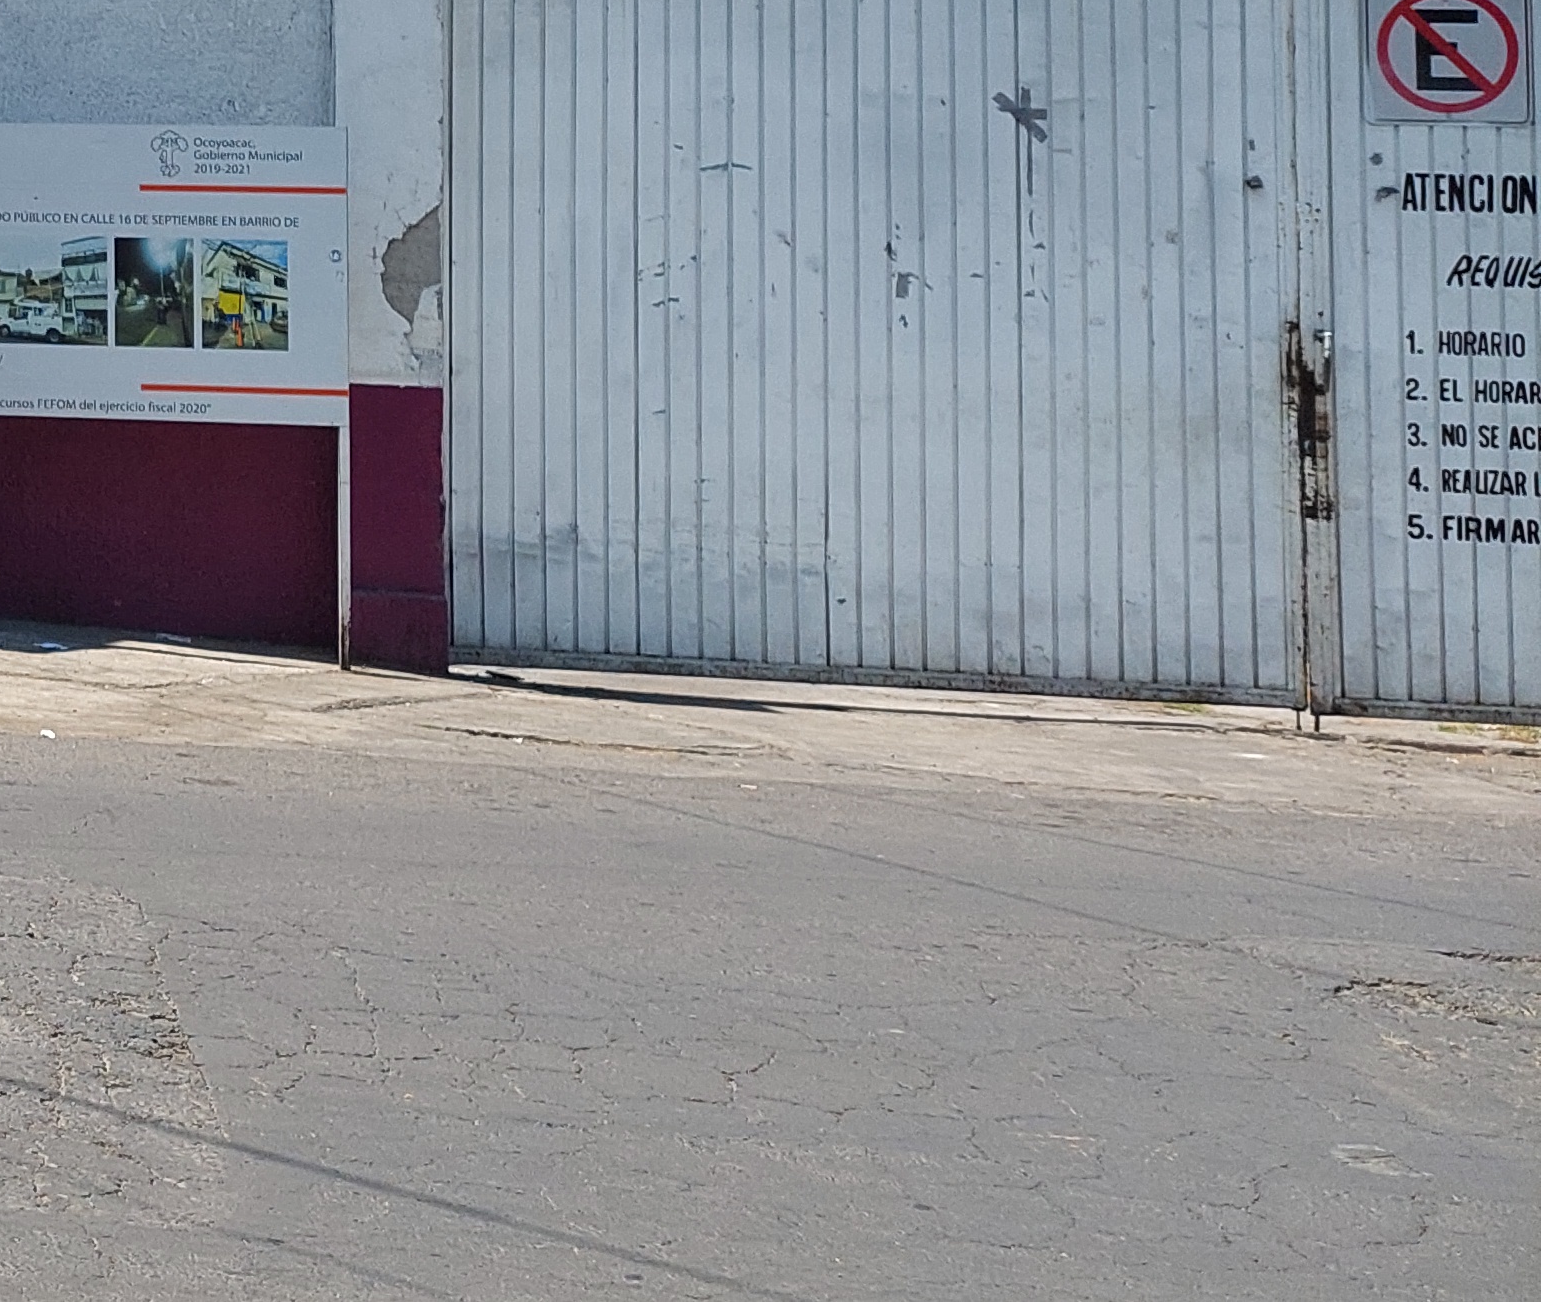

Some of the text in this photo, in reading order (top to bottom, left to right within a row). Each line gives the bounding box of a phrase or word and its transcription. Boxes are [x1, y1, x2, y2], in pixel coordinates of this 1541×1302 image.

[193, 150, 303, 163] Gobierno Municipal
[194, 163, 251, 174] 2019-2021
[1402, 173, 1537, 214] ATENCION
[14, 211, 61, 223] PÚBLICO
[64, 213, 79, 224] EN
[81, 213, 115, 224] CALLE
[118, 214, 132, 225] 16
[134, 214, 149, 225] DE
[151, 214, 219, 226] SEPTIEMBRE
[221, 215, 236, 227] EN
[239, 216, 281, 227] BARRIO
[284, 216, 299, 228] DE
[1406, 329, 1526, 358] 1. HORARIO
[1405, 377, 1541, 405] 2. EL HORAR
[37, 398, 77, 411] FEFOM
[79, 399, 97, 411] del
[99, 401, 145, 414] ejercicio
[148, 401, 176, 413] fiscal
[1407, 422, 1541, 451] 3. NO SE AC
[1408, 466, 1430, 493] 4.
[1441, 469, 1527, 497] REALIZAR
[1407, 514, 1541, 545] 5. FIRMAR
